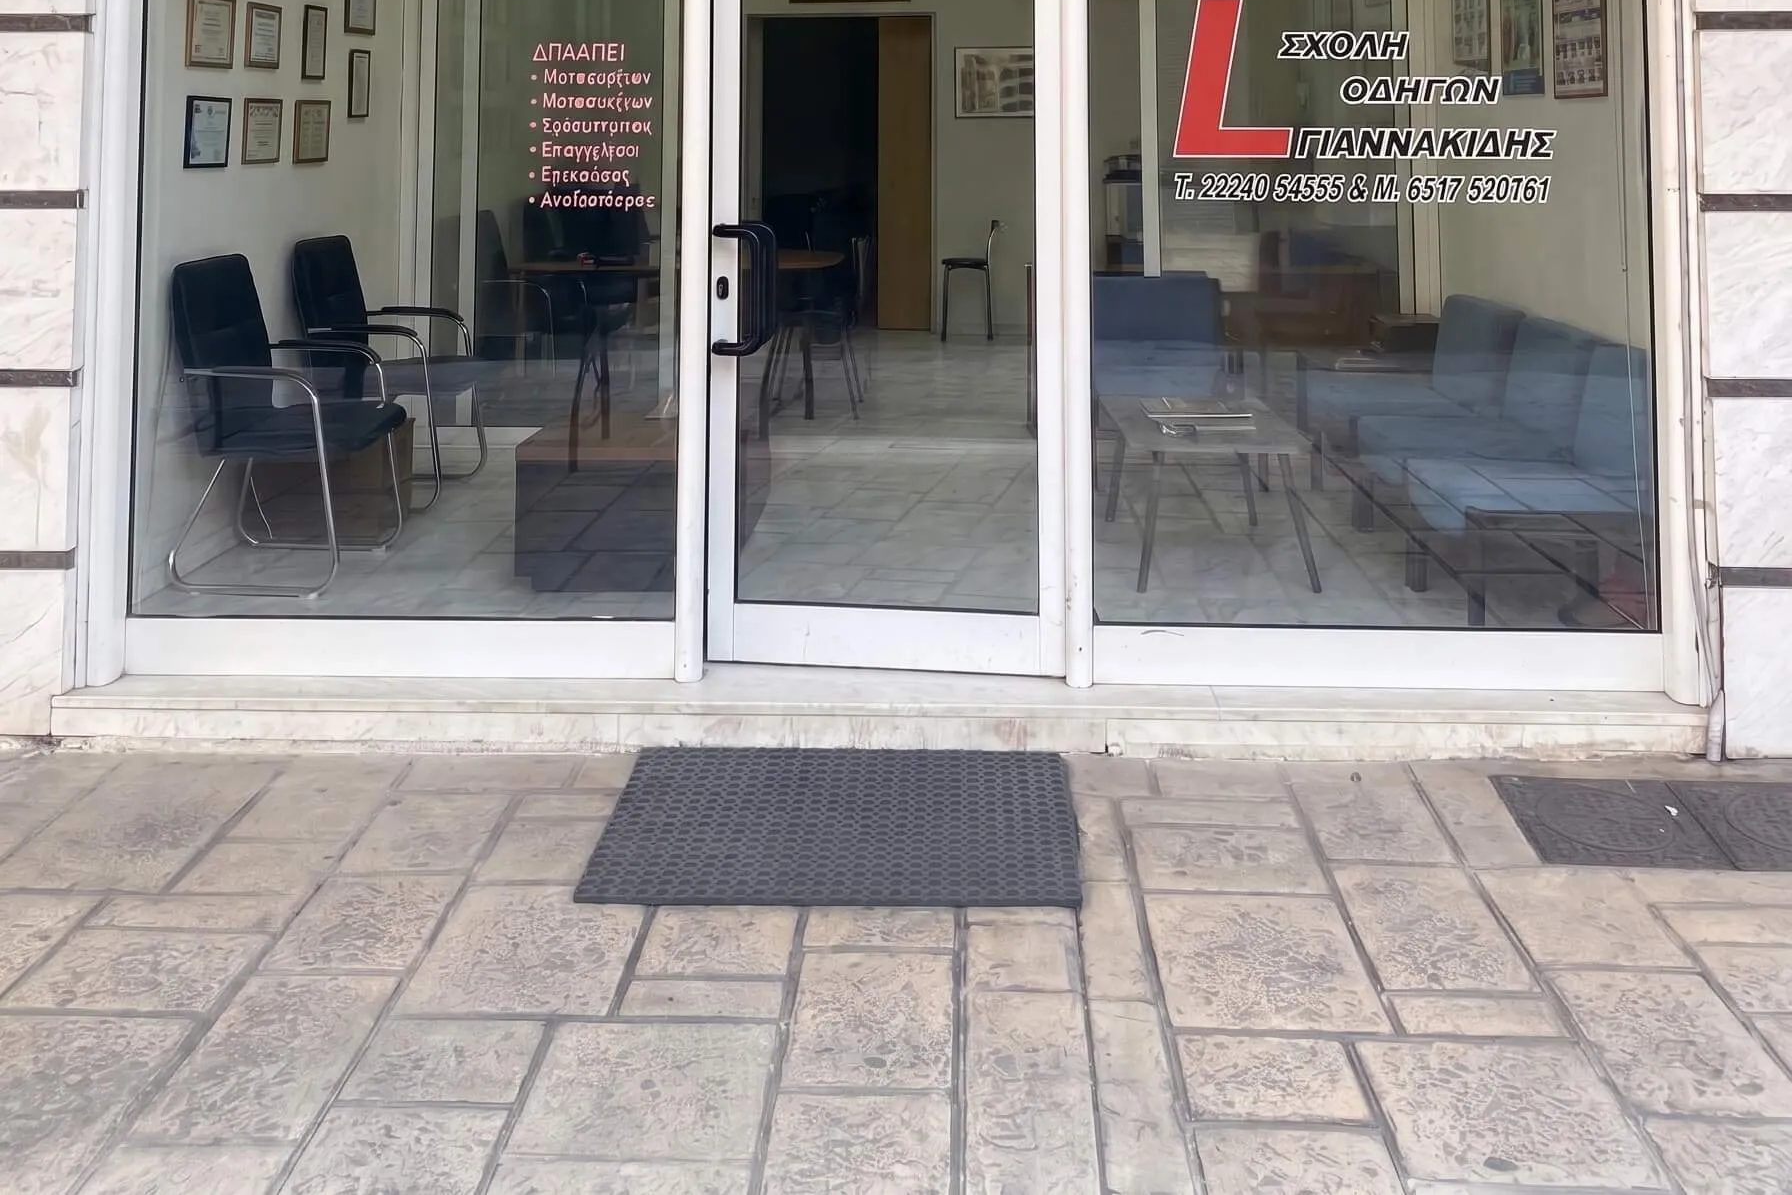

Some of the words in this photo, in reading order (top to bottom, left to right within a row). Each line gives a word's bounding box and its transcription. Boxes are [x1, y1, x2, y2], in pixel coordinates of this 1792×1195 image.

[1277, 31, 1409, 60] ΣΧΟΛΗ
[1340, 76, 1502, 104] ΟΔΗΓΩΝ
[1294, 127, 1558, 159] ΓΙΑΝΝΑΚΙΔΗΣ
[1197, 173, 1270, 201] 22240
[1272, 174, 1345, 202] 54555
[1347, 174, 1368, 202] &
[1406, 175, 1465, 203] 6517
